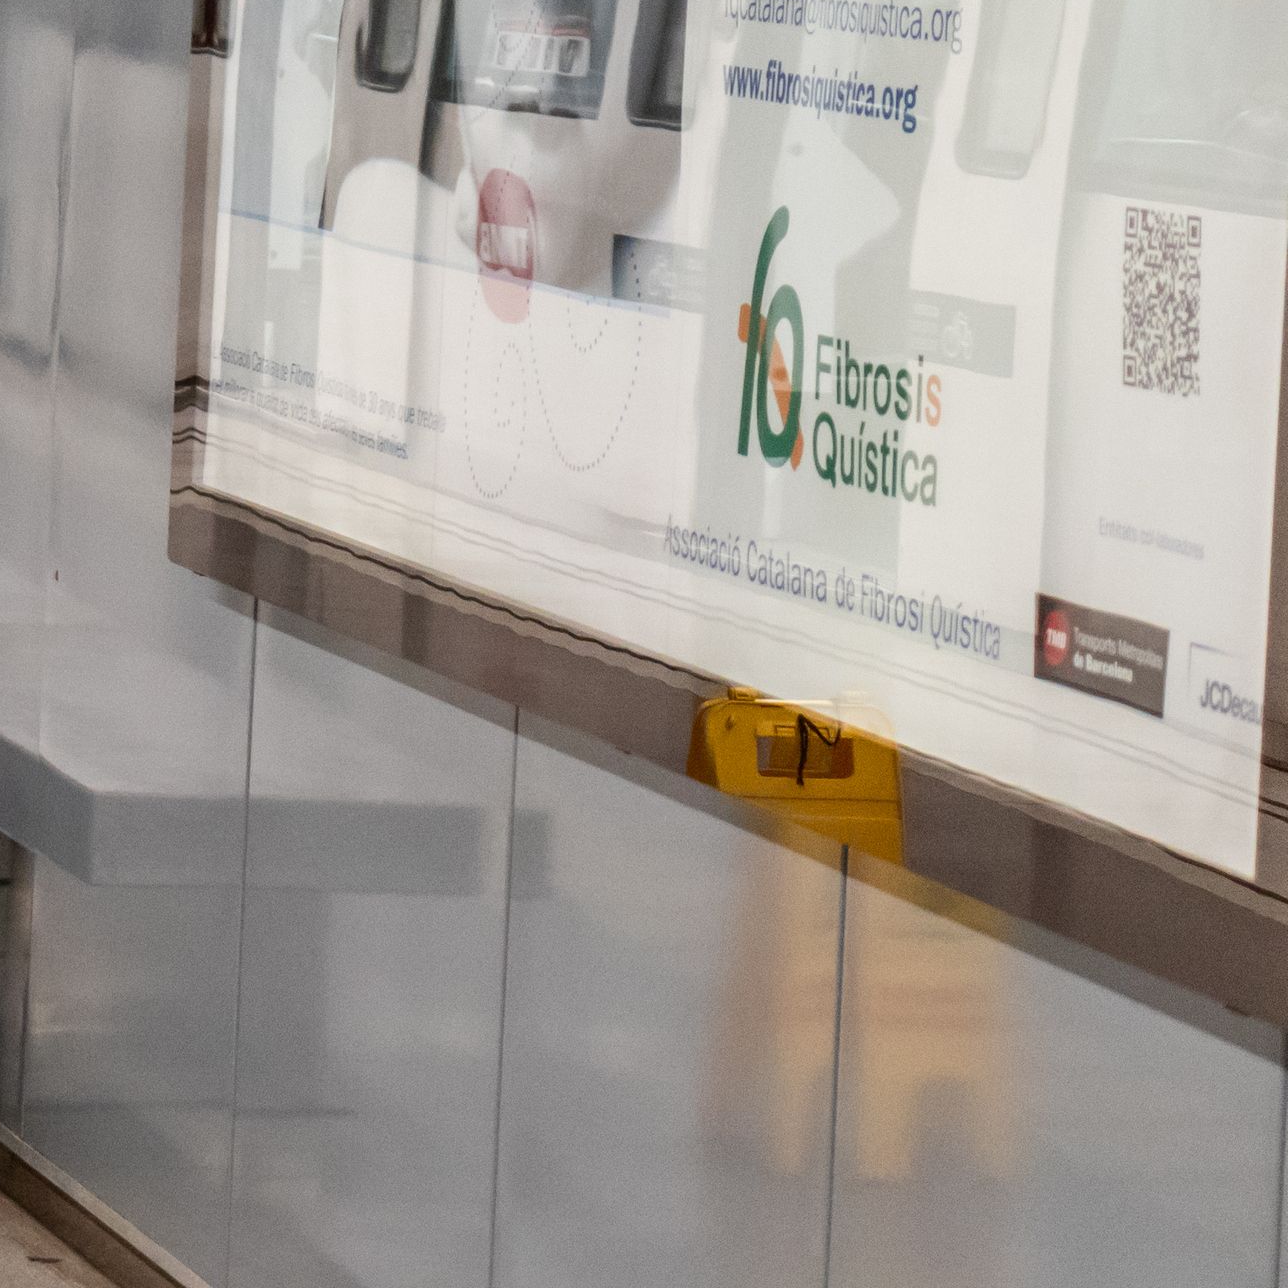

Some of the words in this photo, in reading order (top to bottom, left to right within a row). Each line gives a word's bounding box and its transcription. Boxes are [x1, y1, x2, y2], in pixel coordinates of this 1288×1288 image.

[723, 59, 919, 134] www.fibrosiquistica.org
[815, 334, 942, 428] Fibrosis
[812, 411, 938, 507] Quística
[663, 512, 742, 578] Associació
[746, 539, 828, 603] Catalana
[834, 566, 856, 612] de
[861, 573, 926, 635] Fibrosi
[929, 594, 1001, 661] Quística
